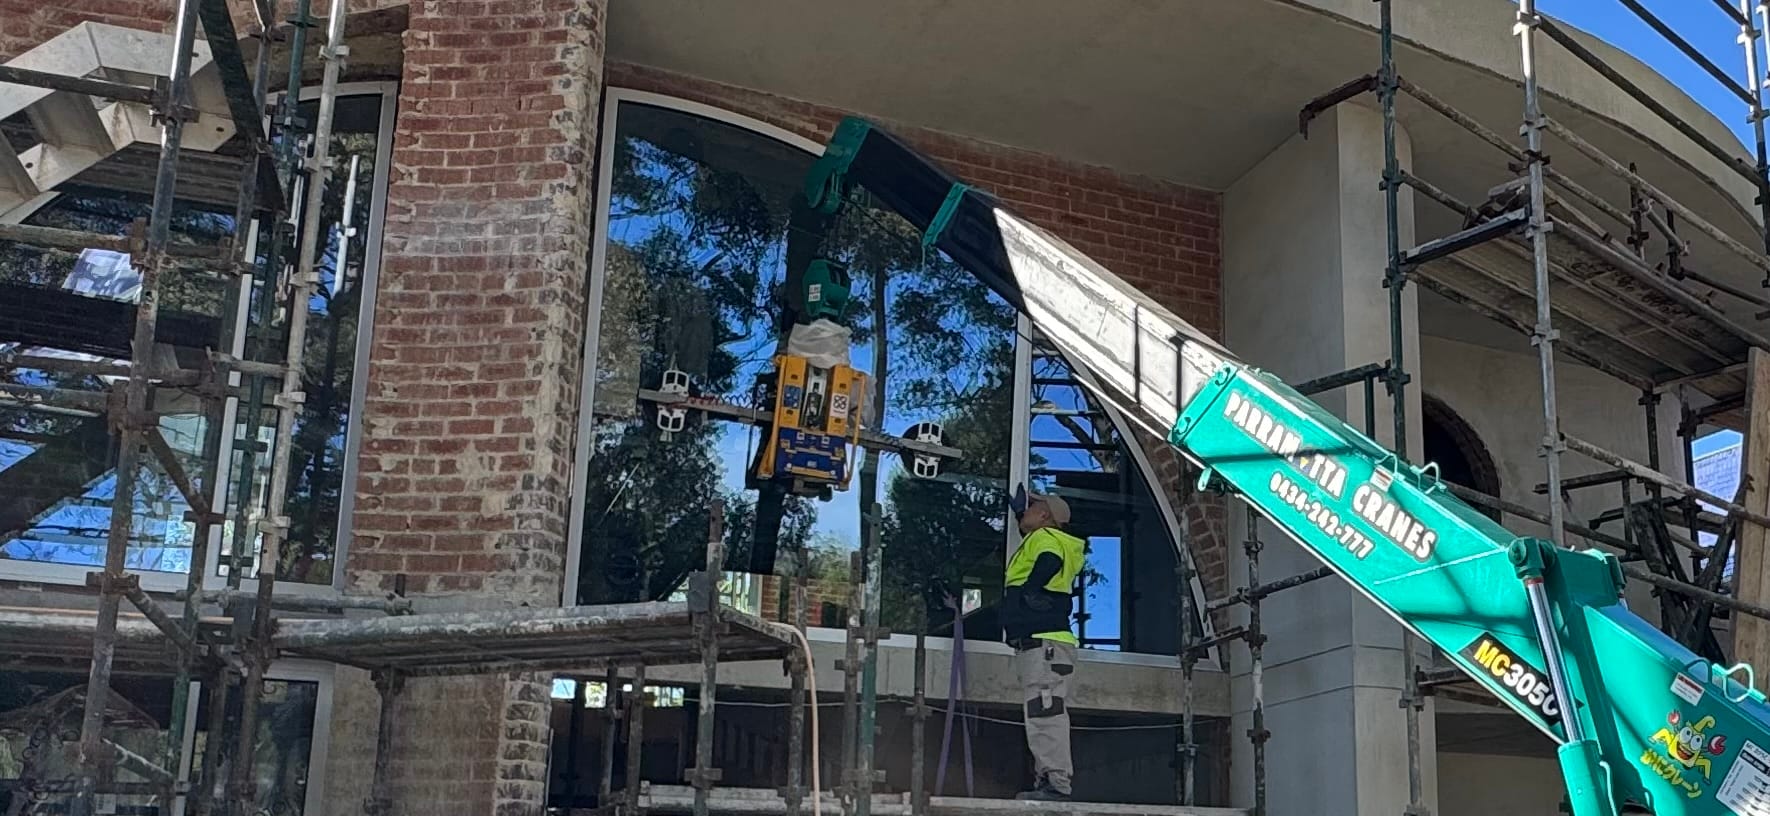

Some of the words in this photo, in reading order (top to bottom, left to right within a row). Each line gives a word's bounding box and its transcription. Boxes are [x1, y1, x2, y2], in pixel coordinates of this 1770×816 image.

[1223, 392, 1348, 500] PARRAMTTA
[1352, 485, 1437, 561] CRANES
[1473, 639, 1559, 716] MC305C
